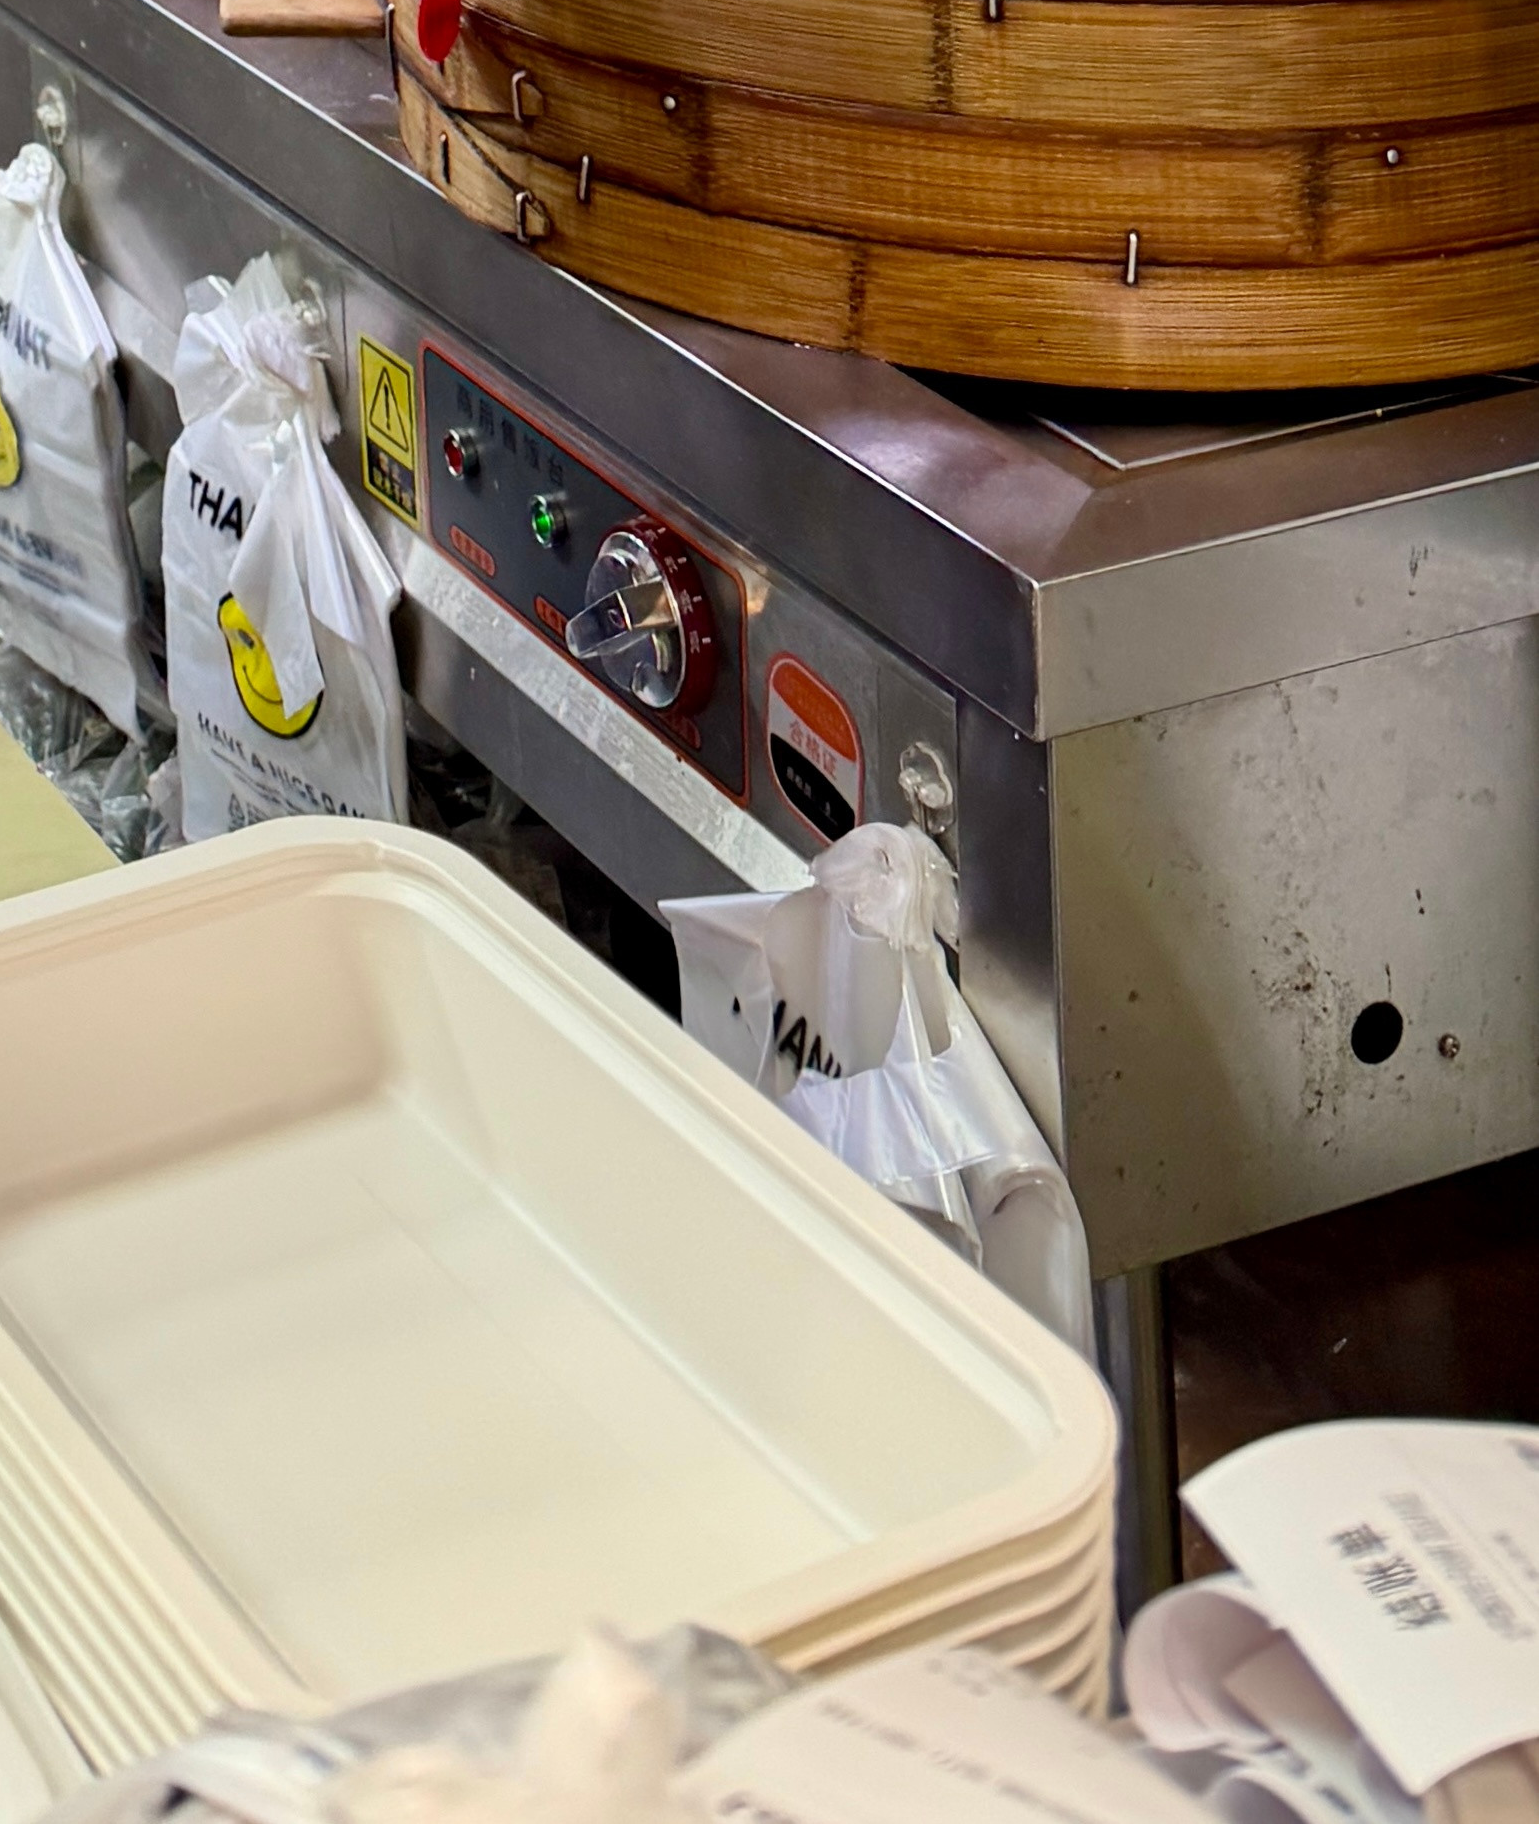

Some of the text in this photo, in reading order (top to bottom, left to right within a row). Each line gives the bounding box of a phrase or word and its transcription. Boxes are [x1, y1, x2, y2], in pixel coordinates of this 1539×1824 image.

[189, 469, 256, 542] THA
[198, 711, 247, 761] HAVE
[251, 753, 265, 773] A
[789, 719, 838, 781] 合格证
